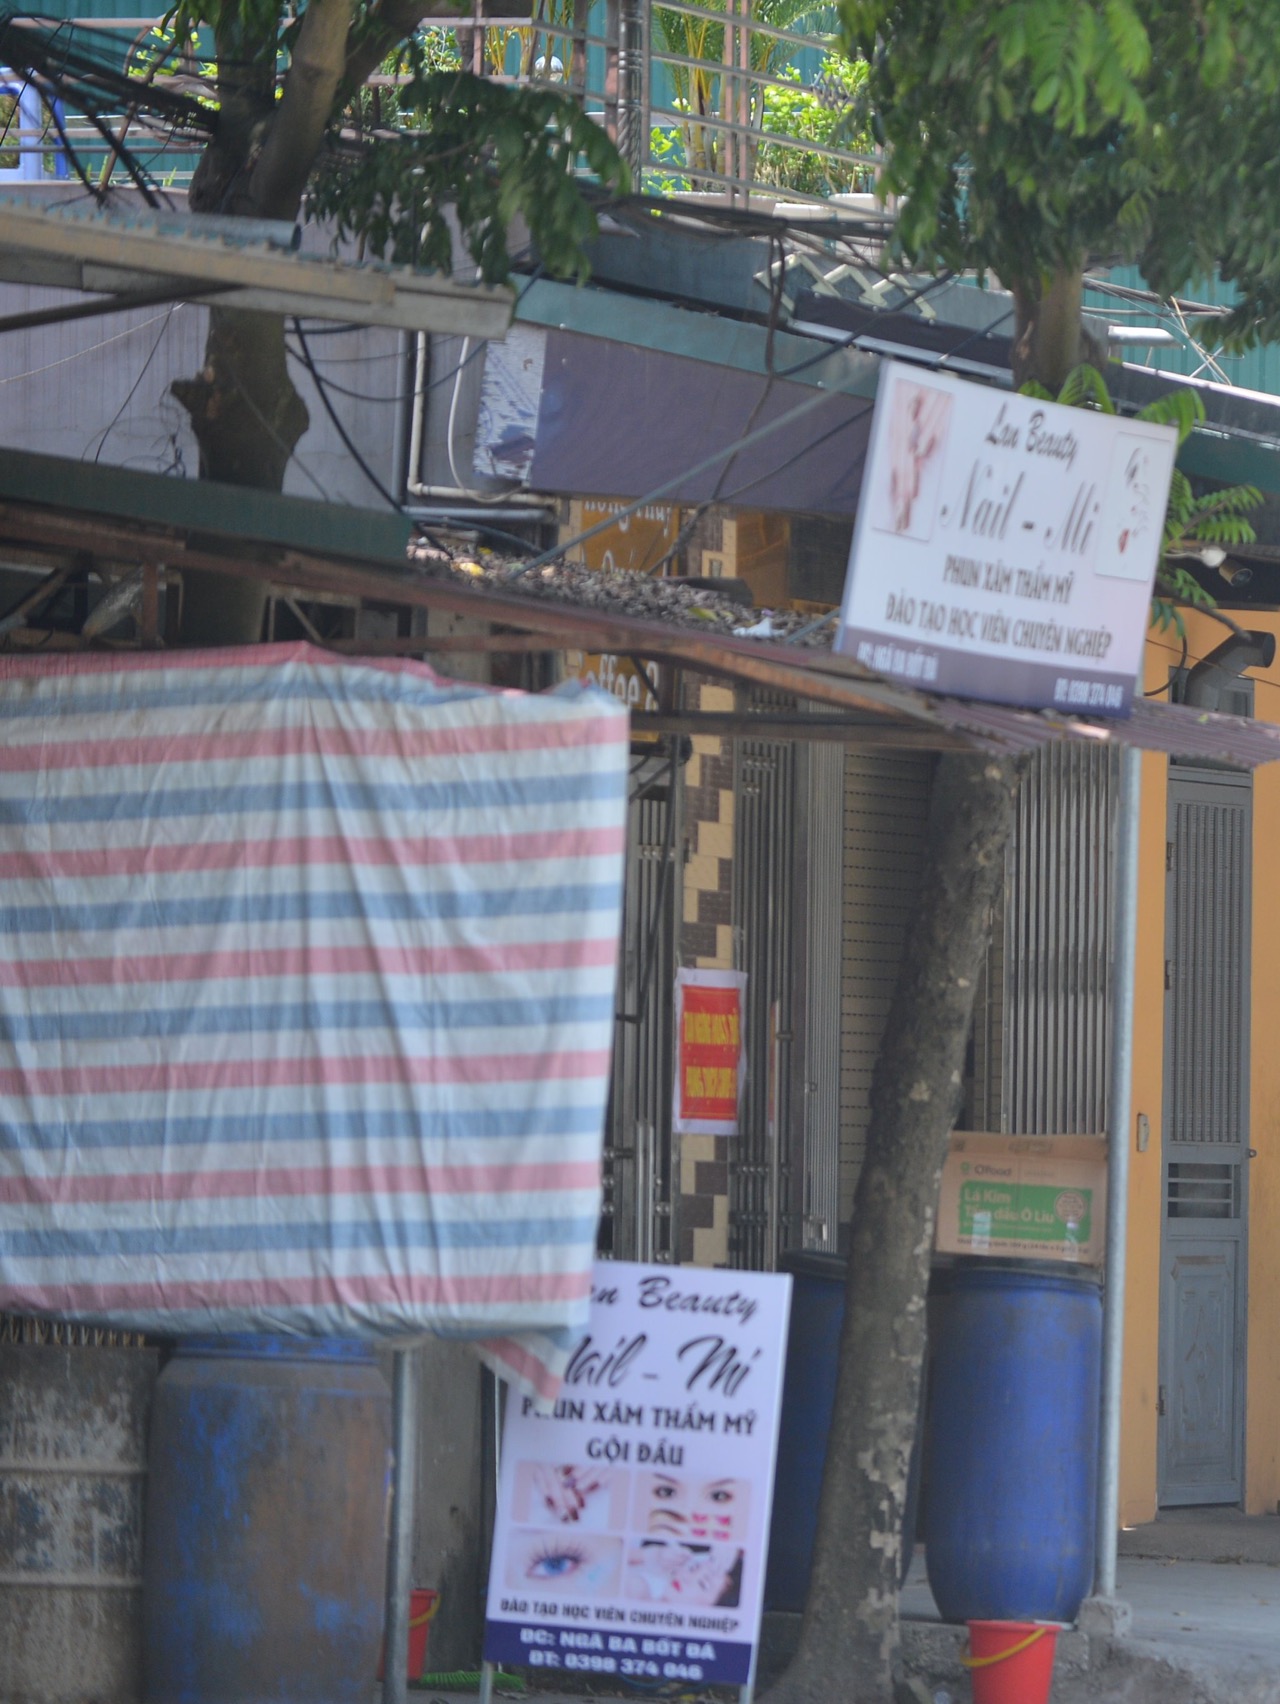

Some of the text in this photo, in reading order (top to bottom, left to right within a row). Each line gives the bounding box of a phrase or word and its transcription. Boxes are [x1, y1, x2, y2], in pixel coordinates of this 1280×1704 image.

[1026, 409, 1079, 472] Beauty
[943, 555, 982, 589] PHUN
[638, 1276, 759, 1326] Beauty
[521, 1397, 584, 1421] PUN
[608, 1636, 637, 1653] BA
